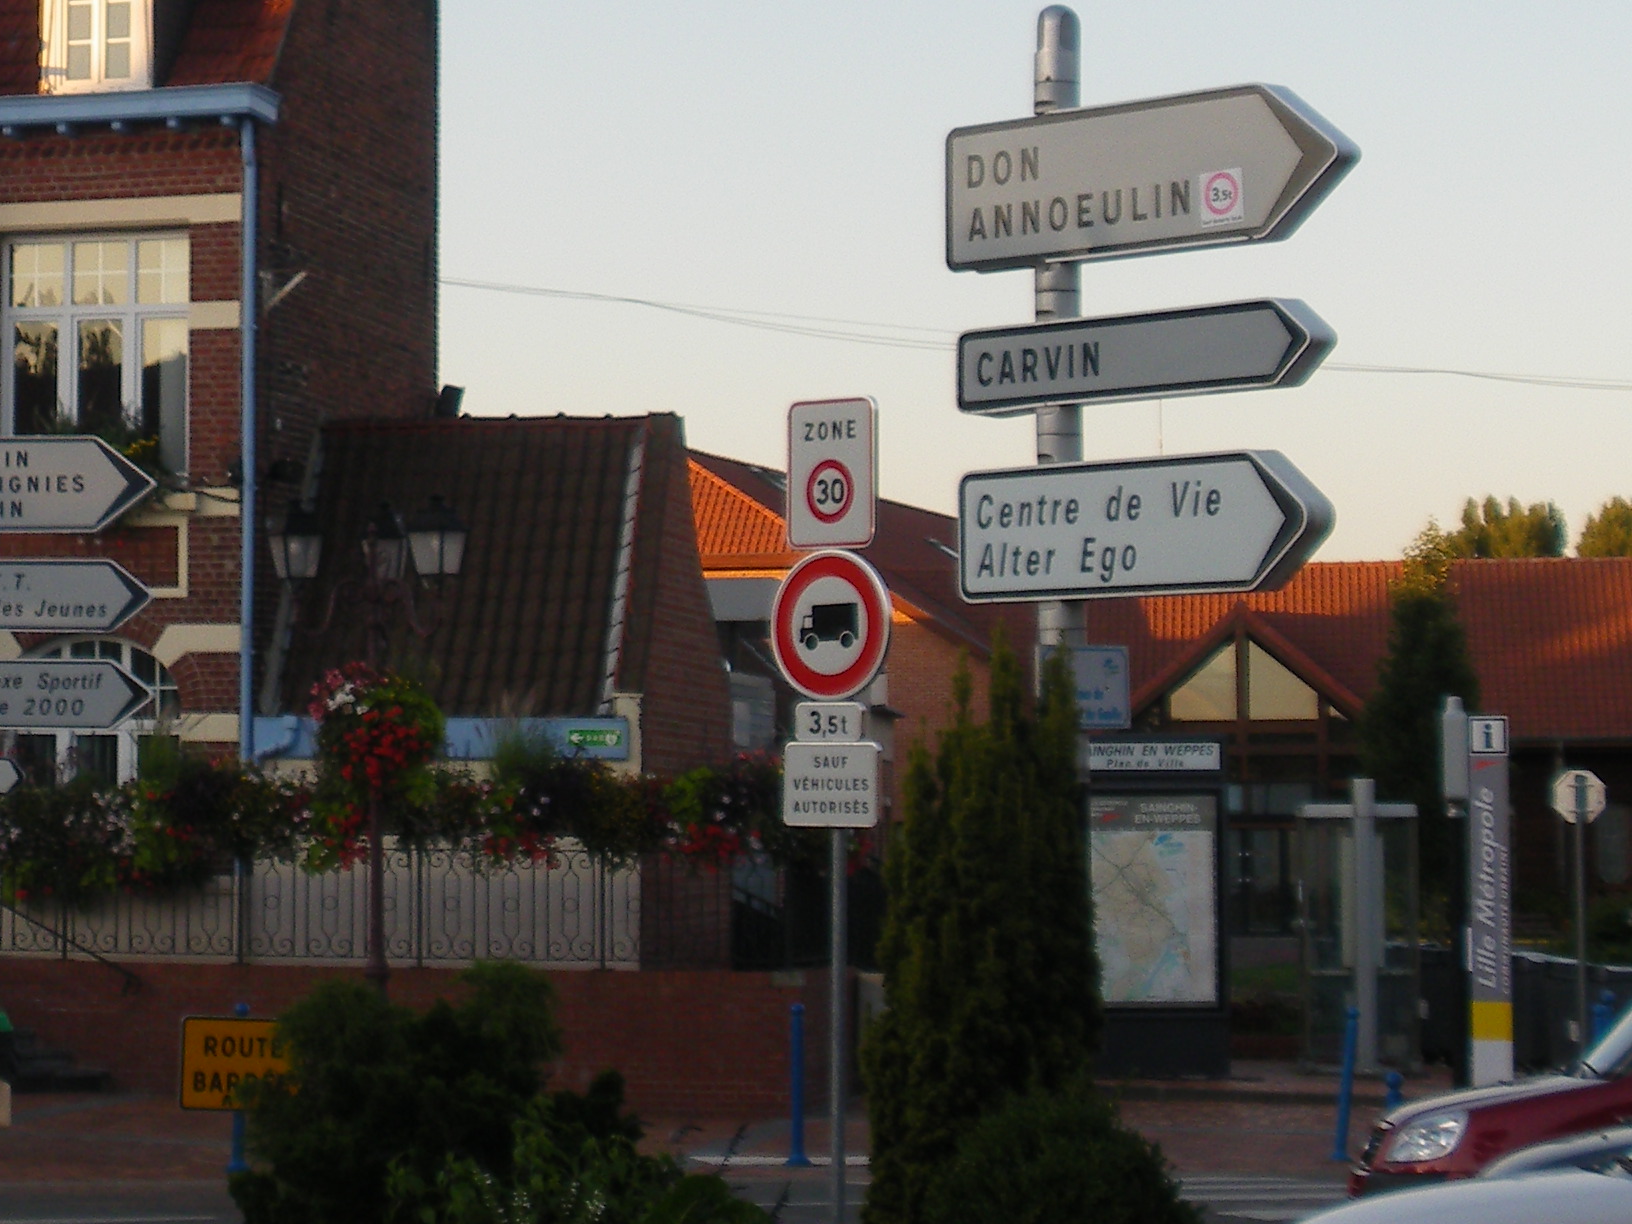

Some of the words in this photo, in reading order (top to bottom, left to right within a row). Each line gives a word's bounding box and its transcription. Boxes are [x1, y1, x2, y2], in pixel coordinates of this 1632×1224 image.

[967, 146, 1040, 189] DON
[968, 179, 1191, 242] ANNOEULIN
[976, 341, 1101, 387] CARVIN
[803, 419, 857, 442] ZONE
[816, 478, 845, 506] 30
[976, 493, 1080, 530] Centre
[1105, 485, 1142, 522] de
[1171, 479, 1222, 517] Vie
[976, 541, 1056, 578] Alter
[1080, 536, 1138, 583] Ego
[34, 599, 108, 618] Jeunes
[36, 671, 105, 694] Sportif
[22, 698, 86, 717] 2000
[808, 710, 849, 738] 3,5t
[813, 756, 849, 769] SAUF
[1089, 745, 1136, 757] INGHIN
[1141, 745, 1159, 757] EN
[1164, 745, 1215, 757] WEPPES
[793, 776, 870, 792] VÉHICULES
[1473, 787, 1508, 927] Métropole
[1475, 935, 1497, 988] Lille
[204, 1036, 284, 1058] ROUTE
